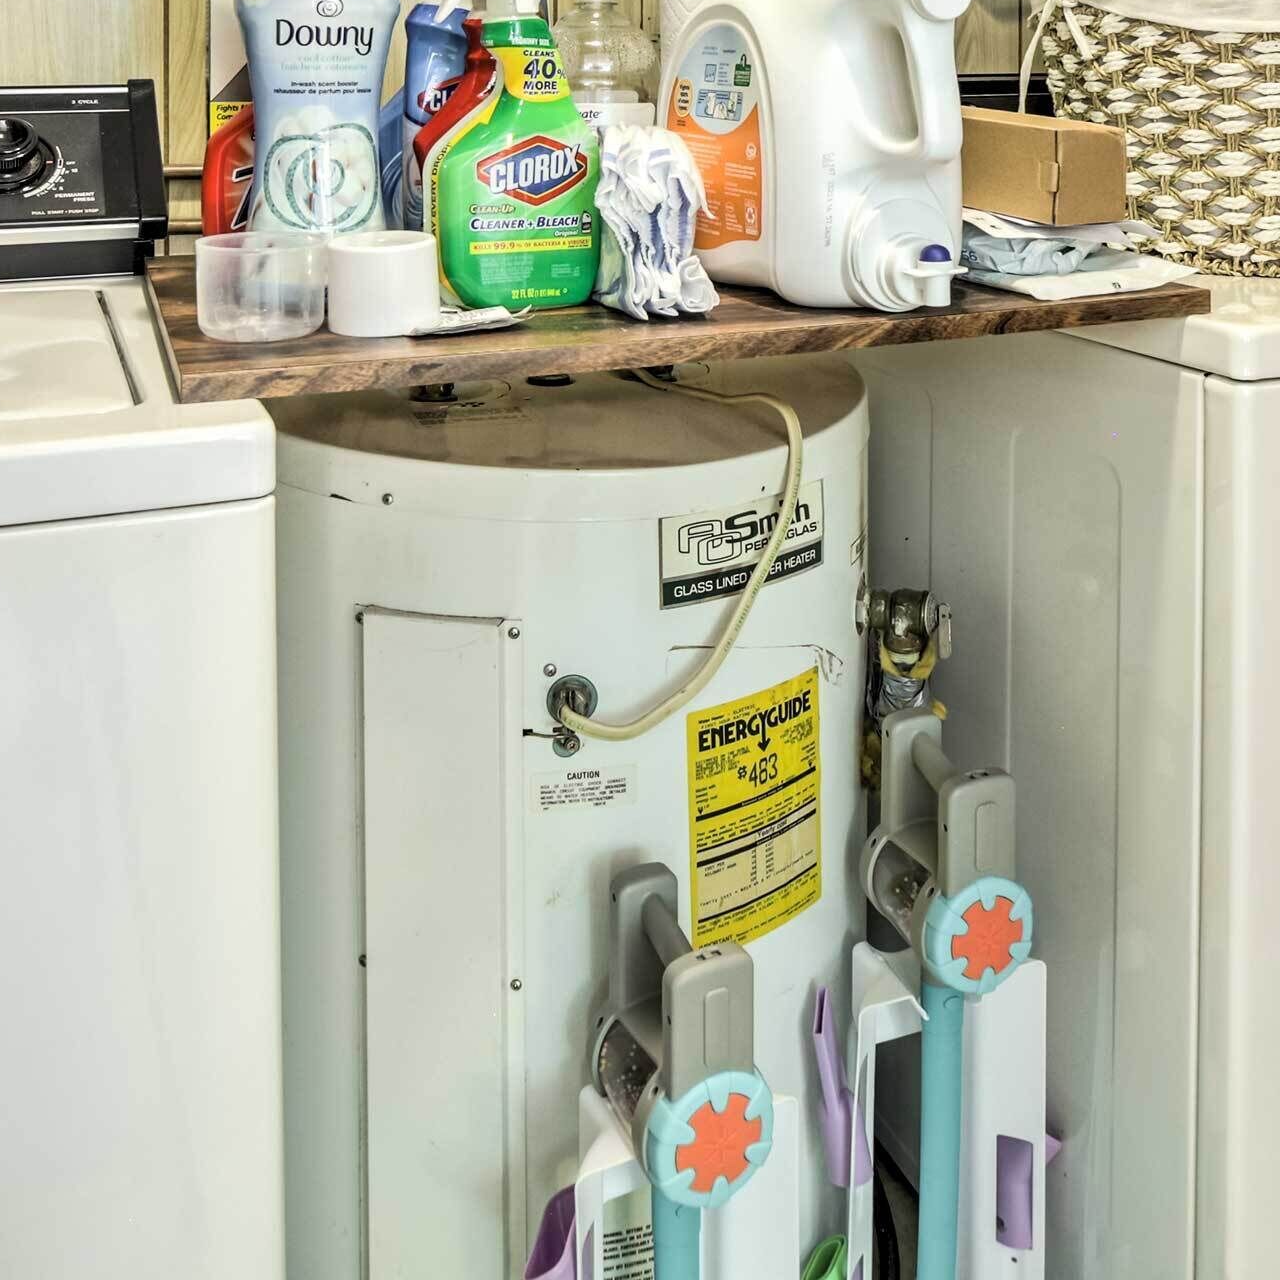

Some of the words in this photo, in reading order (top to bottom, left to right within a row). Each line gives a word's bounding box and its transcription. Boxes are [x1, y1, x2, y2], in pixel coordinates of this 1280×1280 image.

[275, 19, 375, 56] Downy
[523, 49, 555, 57] CLEANS
[523, 81, 557, 90] MORE
[216, 104, 239, 113] Fights
[489, 143, 582, 195] CLOROX
[470, 204, 516, 215] CLEAN-UP
[470, 218, 525, 231] CLEANER
[536, 216, 579, 228] BLEACH
[533, 240, 561, 248] BACTERIA
[724, 498, 811, 544] Smh
[744, 521, 818, 554] PERGLAS
[783, 548, 817, 571] HEATER
[673, 580, 714, 598] GLASS
[716, 571, 748, 590] LINED
[698, 688, 812, 753] ENERGYGUIDE
[566, 770, 600, 781] CAUTION
[737, 752, 779, 788] $483
[757, 825, 776, 839] Yearly
[775, 819, 788, 831] cost
